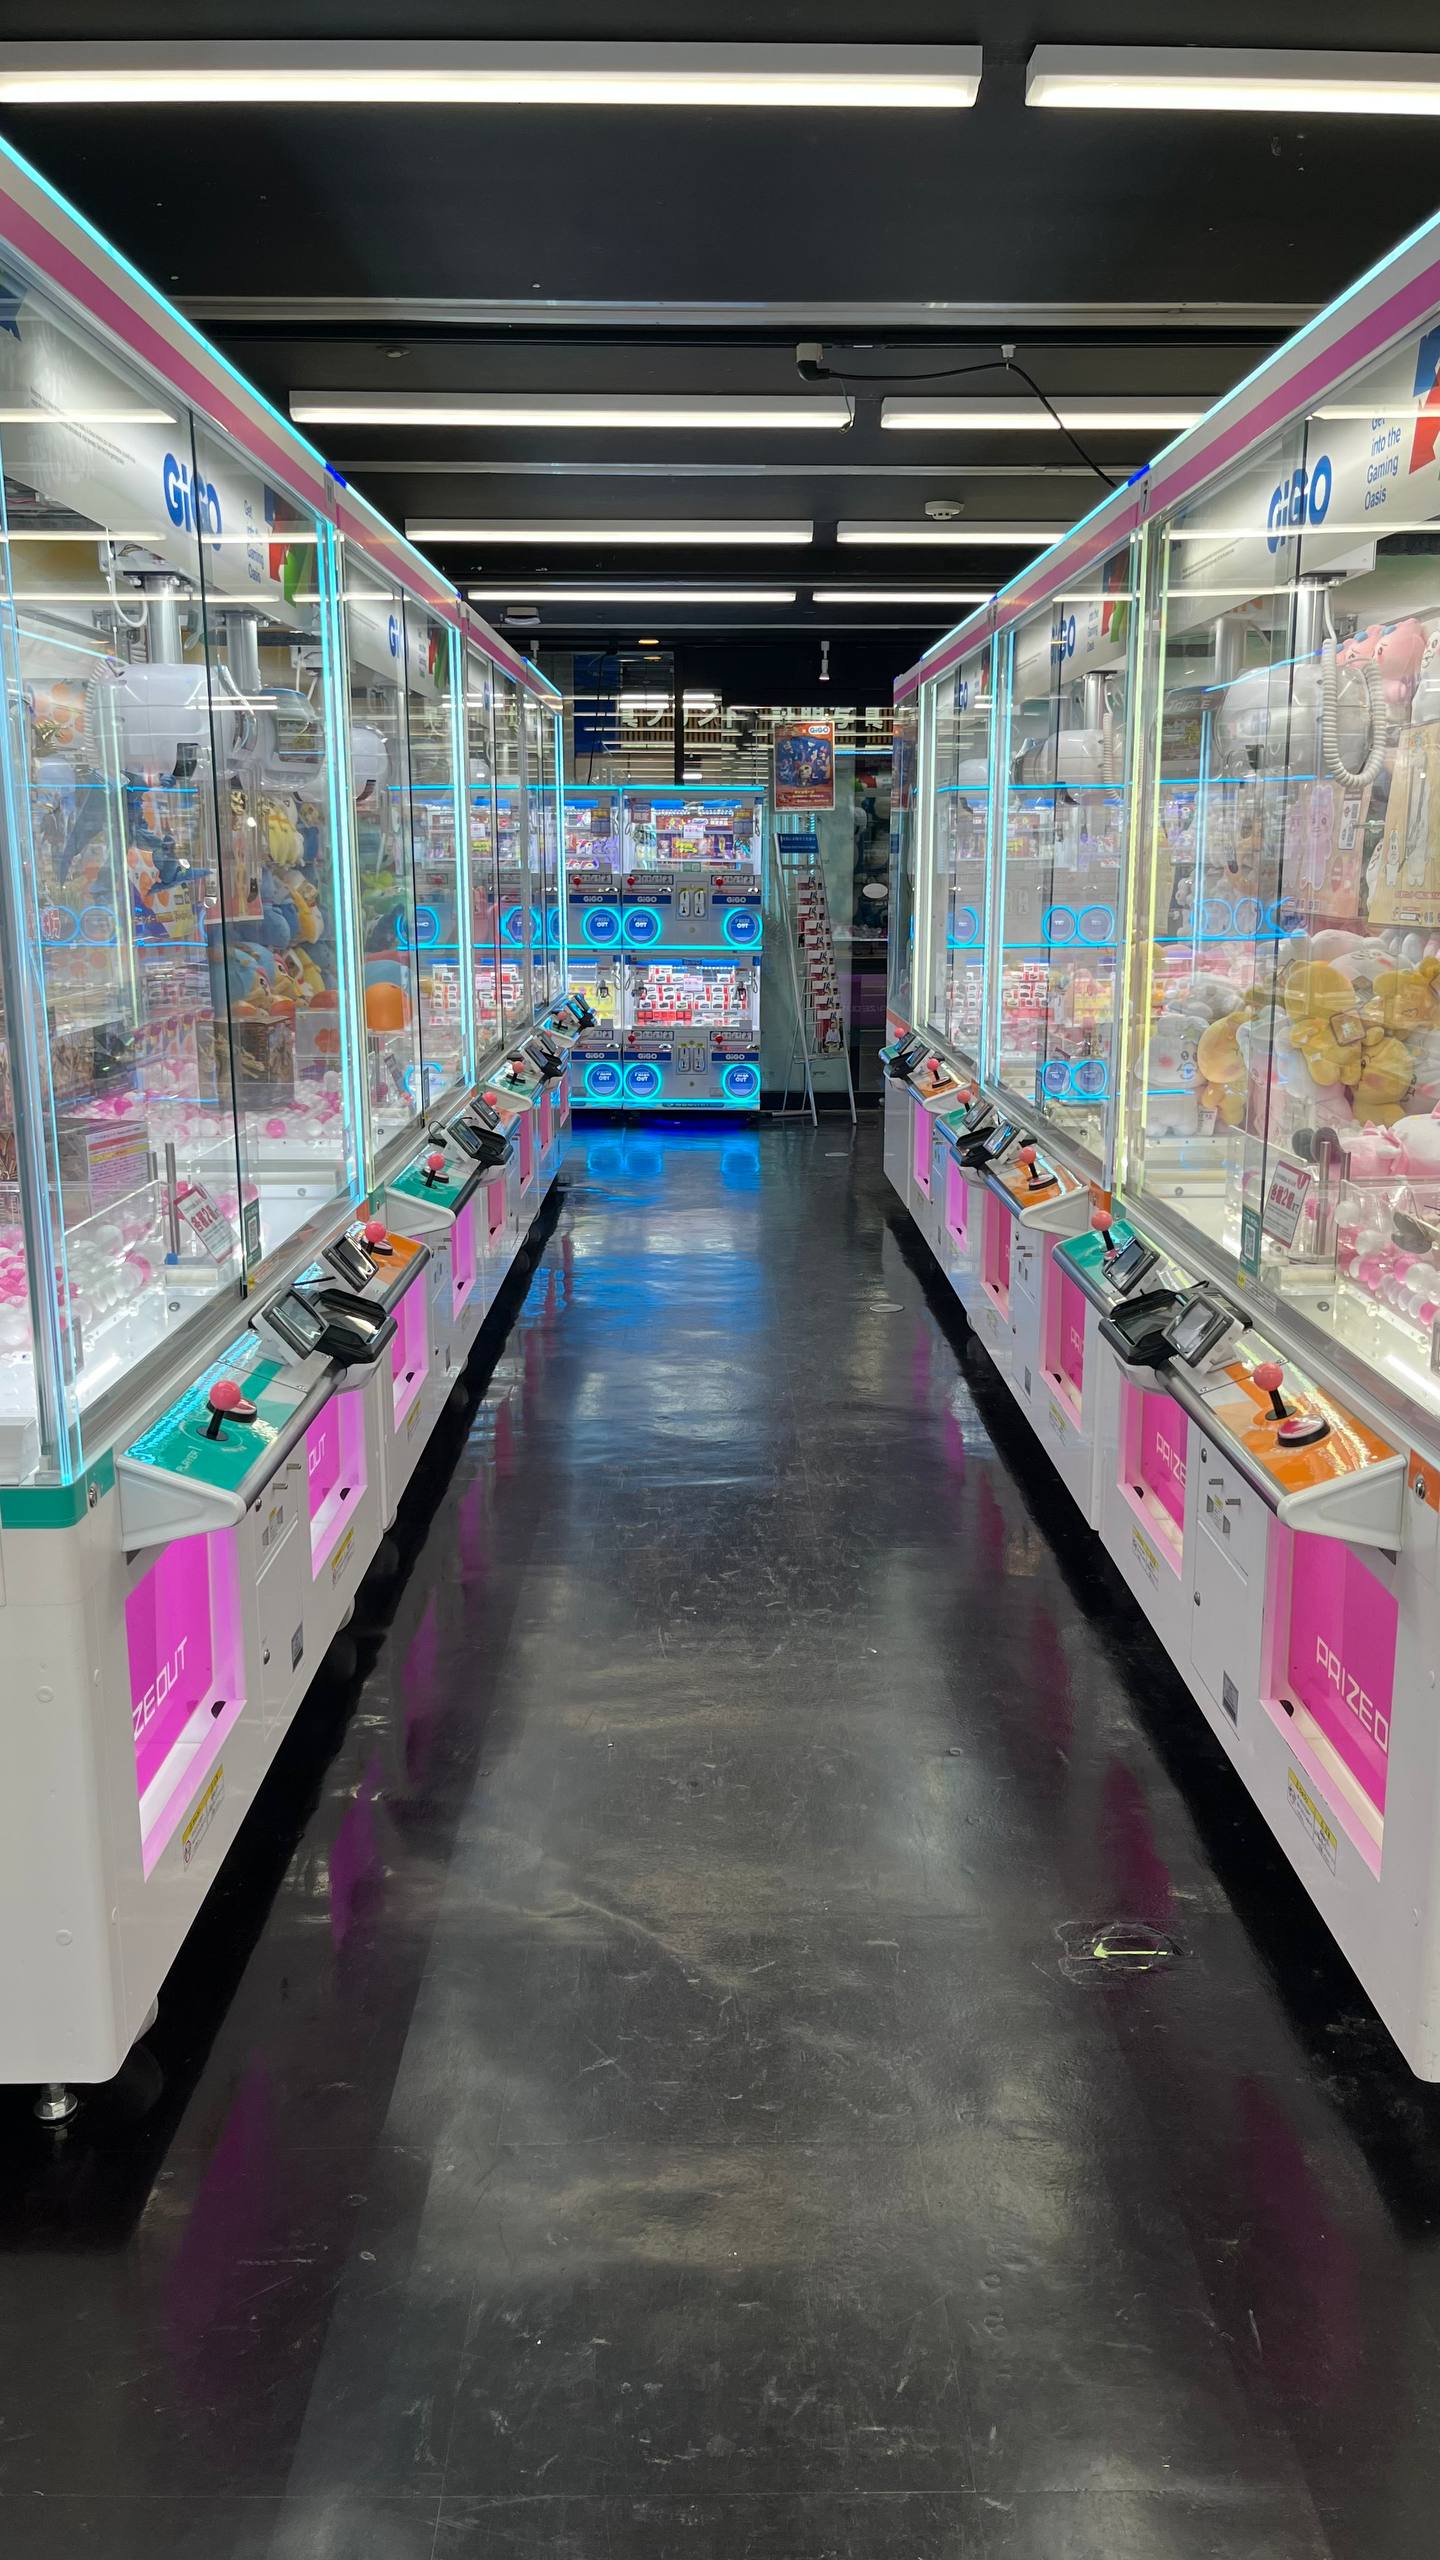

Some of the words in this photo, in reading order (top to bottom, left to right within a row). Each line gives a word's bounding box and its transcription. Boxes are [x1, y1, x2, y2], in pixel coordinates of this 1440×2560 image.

[1371, 439, 1386, 457] into
[1387, 427, 1401, 446] the
[1367, 455, 1399, 484] Gaming
[163, 452, 222, 551] GiGO
[1267, 455, 1333, 554] GiGO
[1364, 486, 1387, 511] Oasis
